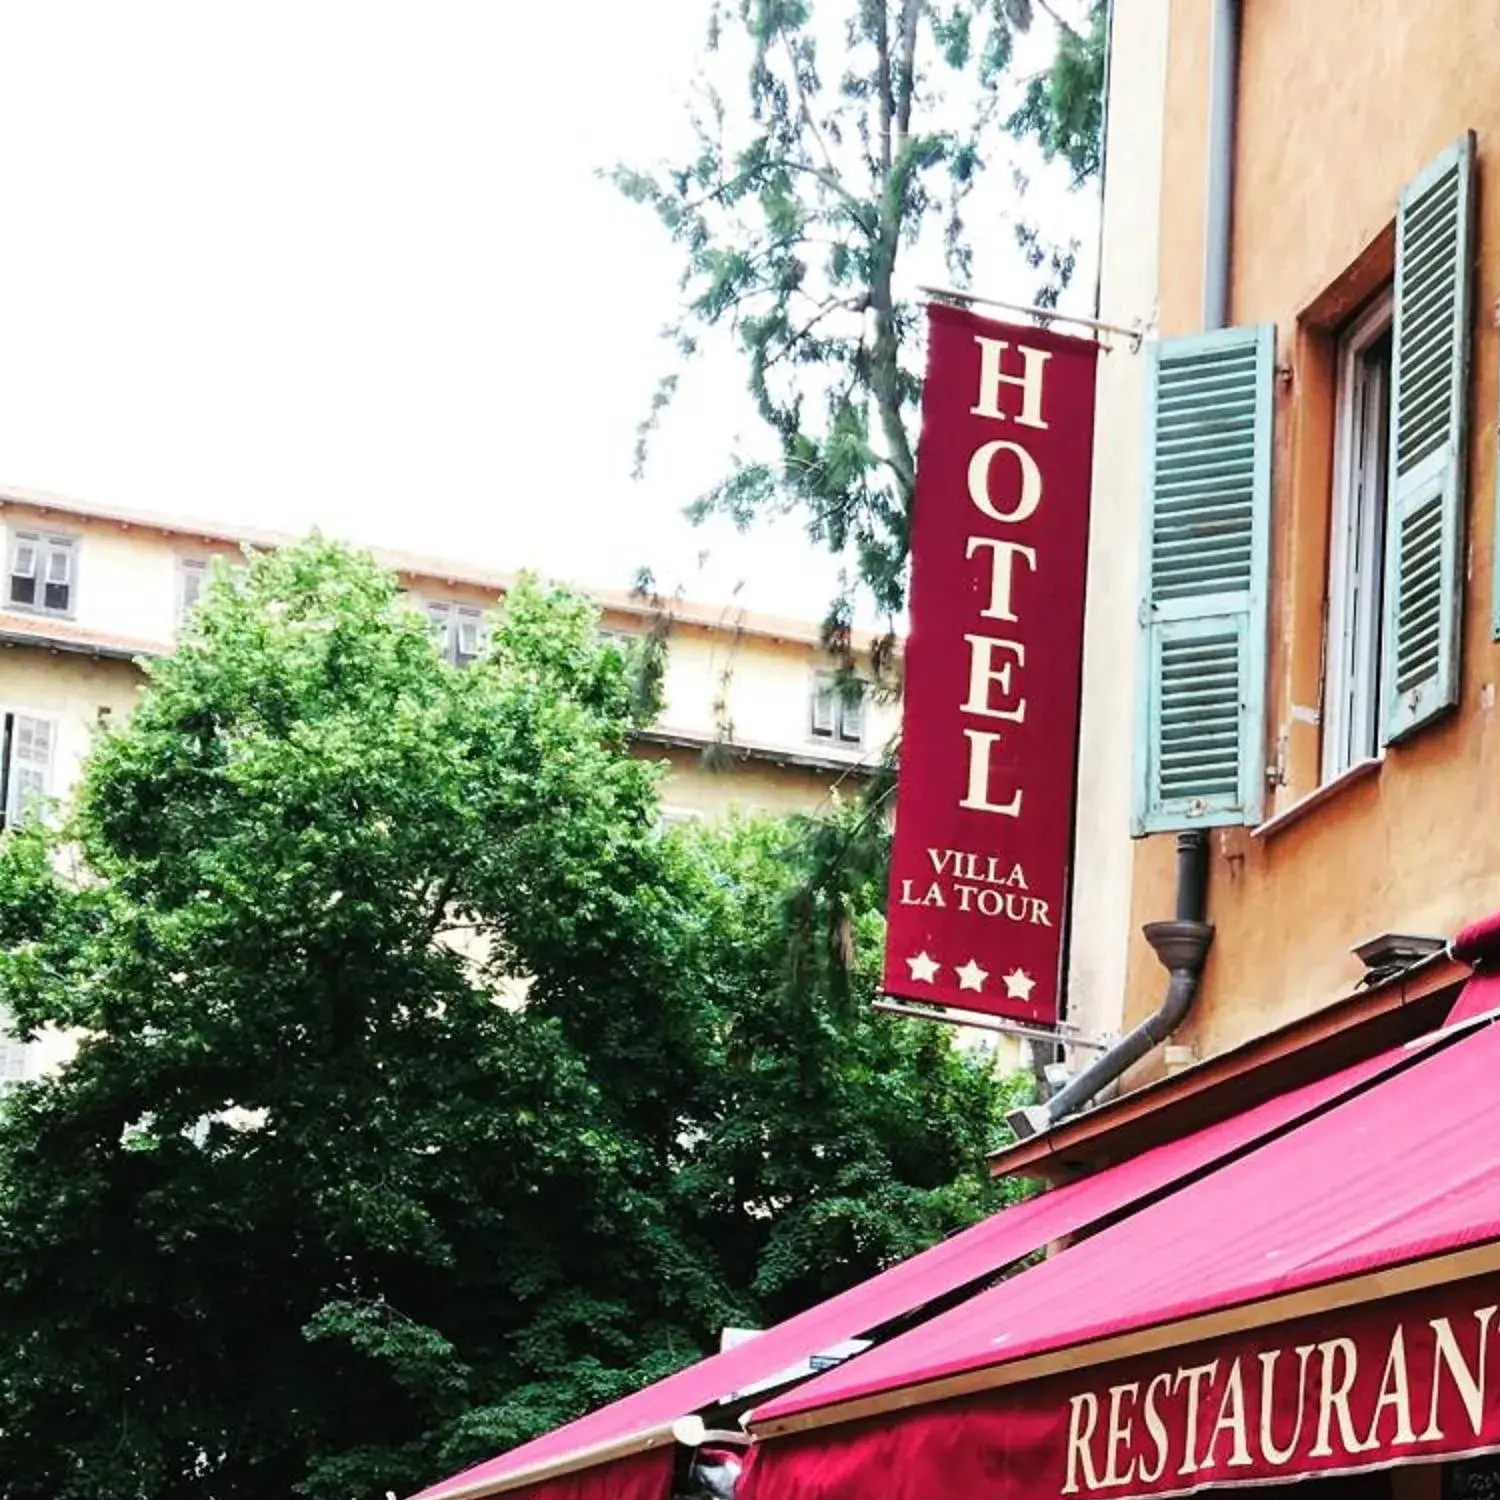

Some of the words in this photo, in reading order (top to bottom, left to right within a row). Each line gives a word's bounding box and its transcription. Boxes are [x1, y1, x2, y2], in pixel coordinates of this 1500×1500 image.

[958, 334, 1053, 817] HOTEL
[926, 847, 1029, 890] VILLA
[901, 878, 946, 908] LA
[953, 883, 1053, 928] TOUR
